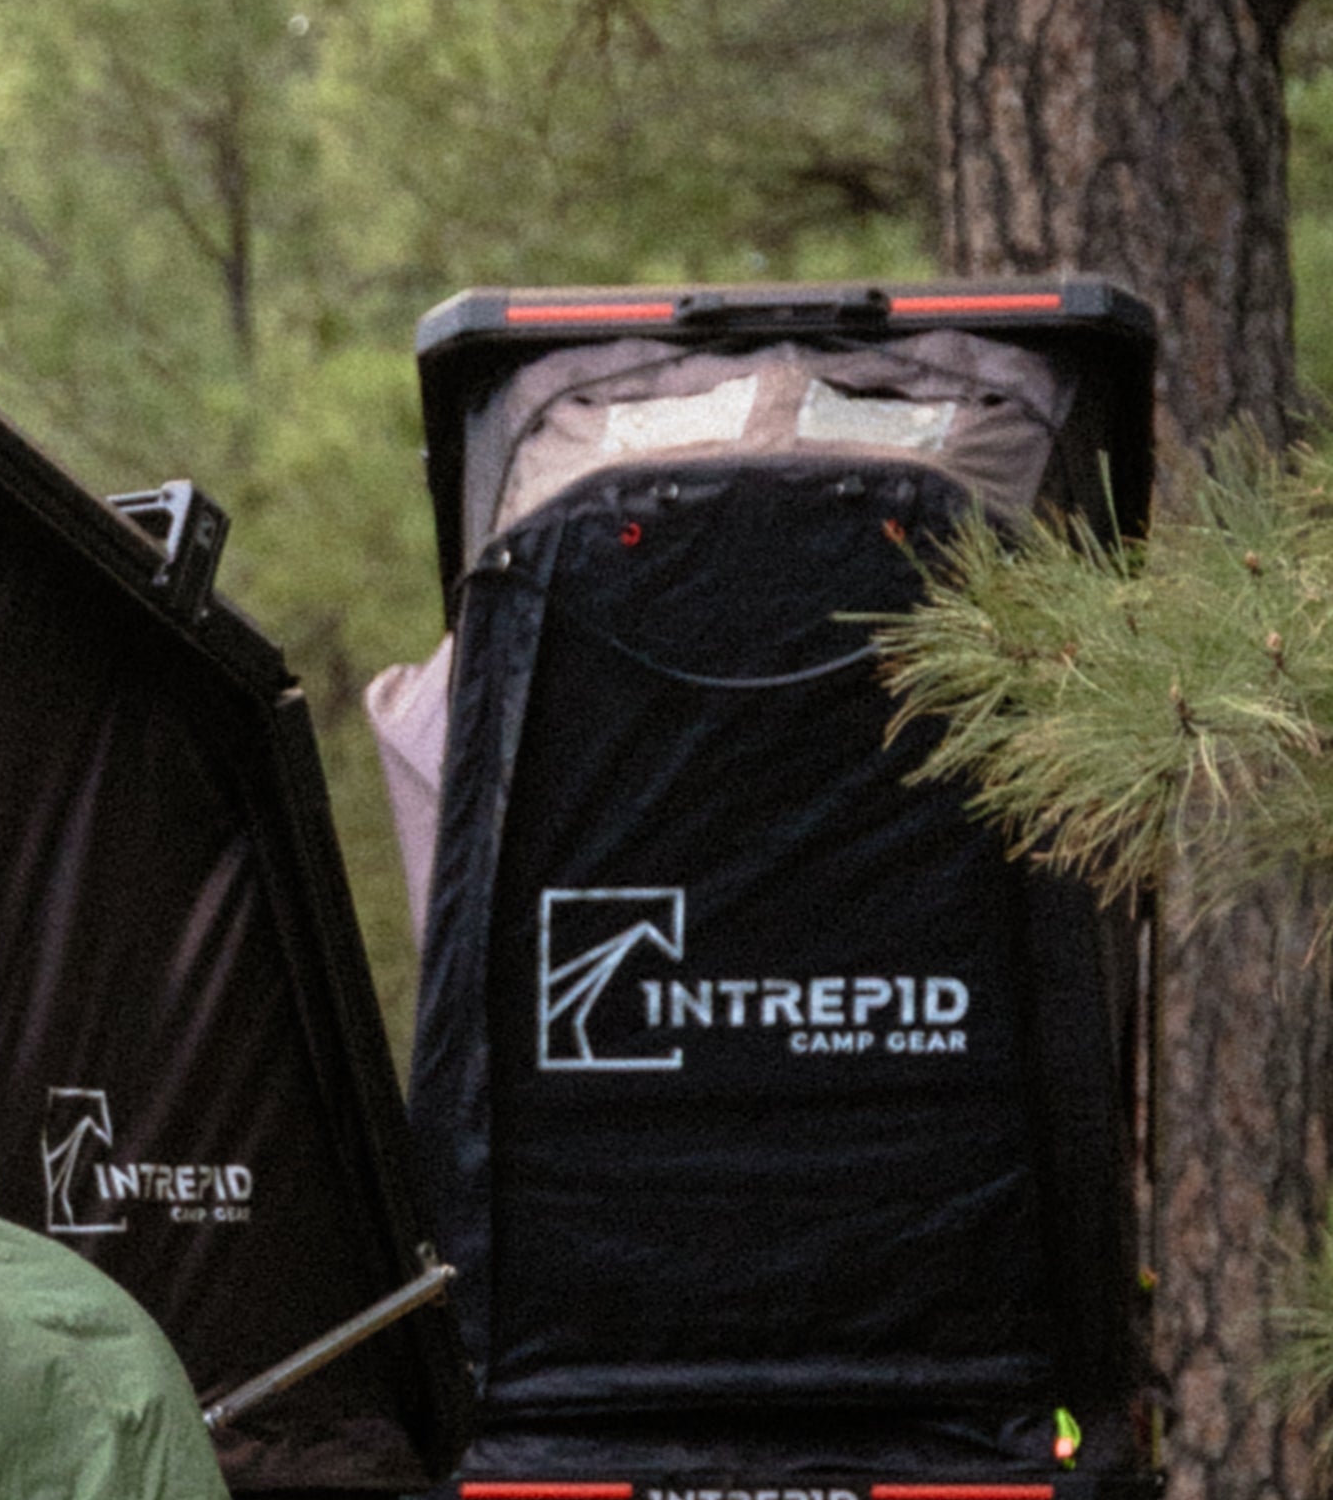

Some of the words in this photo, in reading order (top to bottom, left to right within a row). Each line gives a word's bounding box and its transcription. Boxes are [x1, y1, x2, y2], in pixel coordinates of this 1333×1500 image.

[642, 976, 970, 1028] INTREPID
[790, 1031, 875, 1054] CAMP
[886, 1030, 968, 1053] GEAR
[93, 1162, 253, 1201] INTREPID
